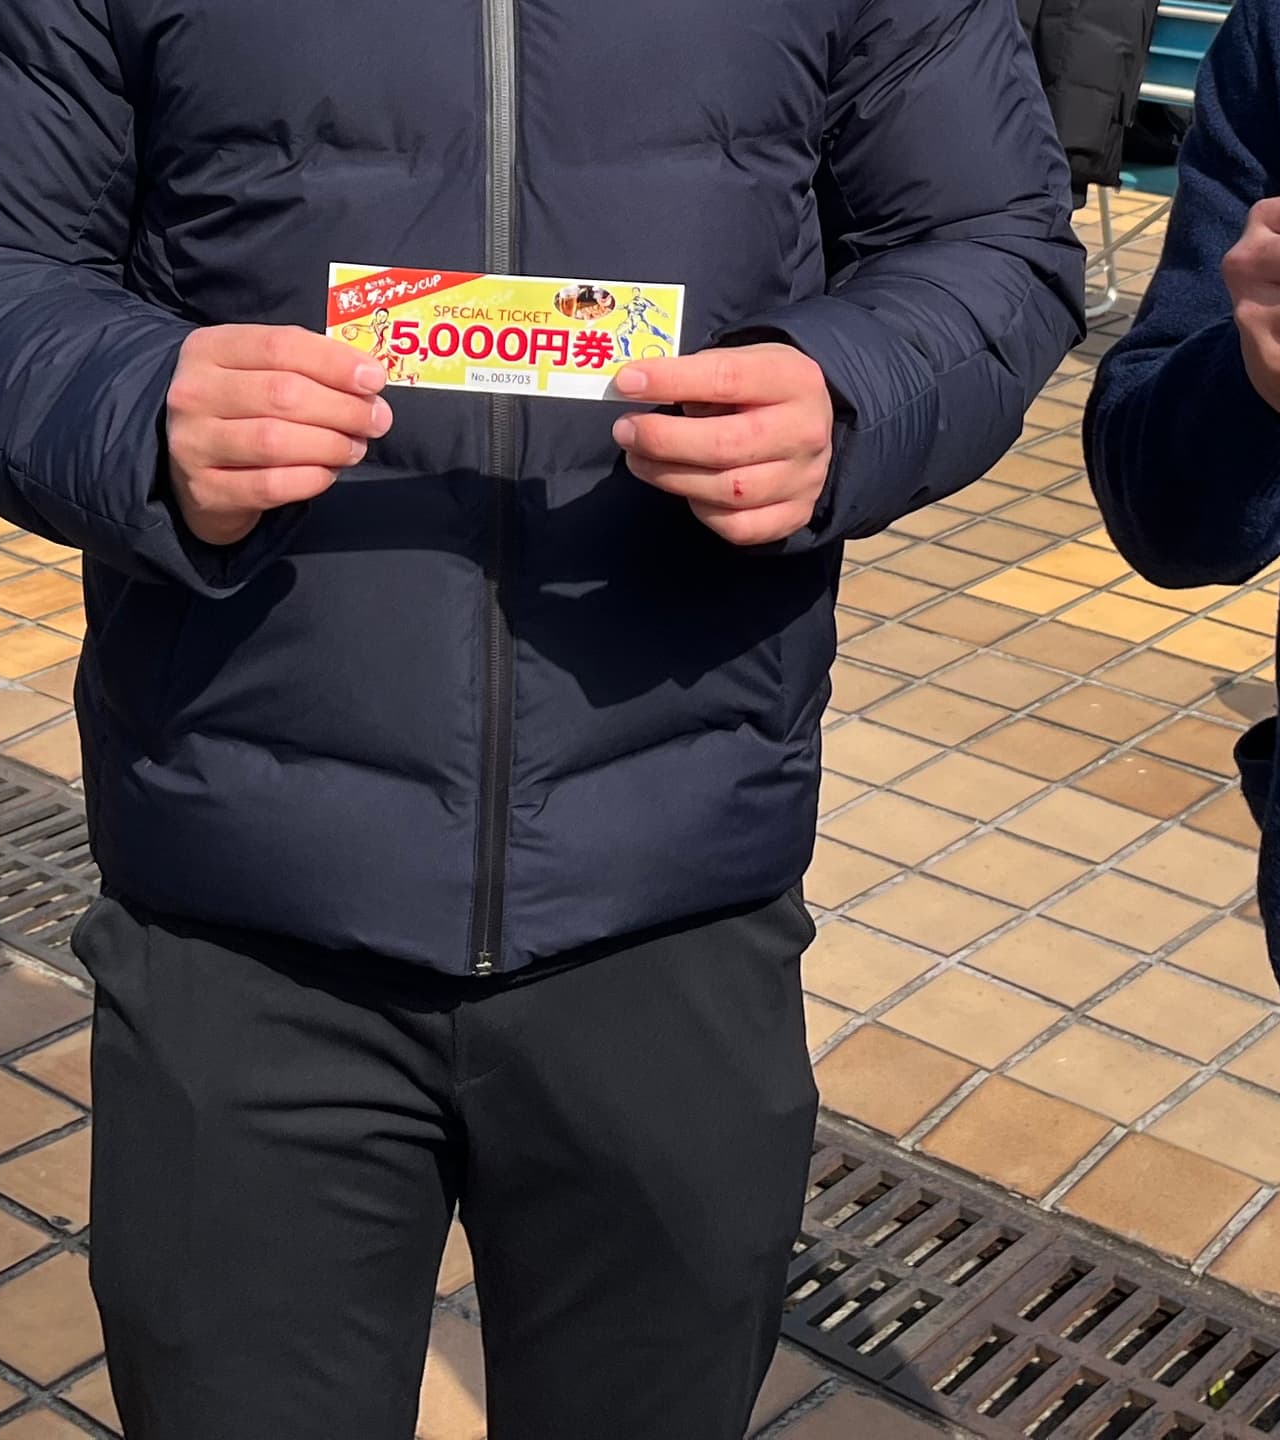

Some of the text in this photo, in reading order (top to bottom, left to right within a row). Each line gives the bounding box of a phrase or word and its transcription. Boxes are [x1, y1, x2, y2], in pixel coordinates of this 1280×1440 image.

[433, 303, 553, 324] SPECIAL TICKET
[389, 320, 614, 369] 5,000円券
